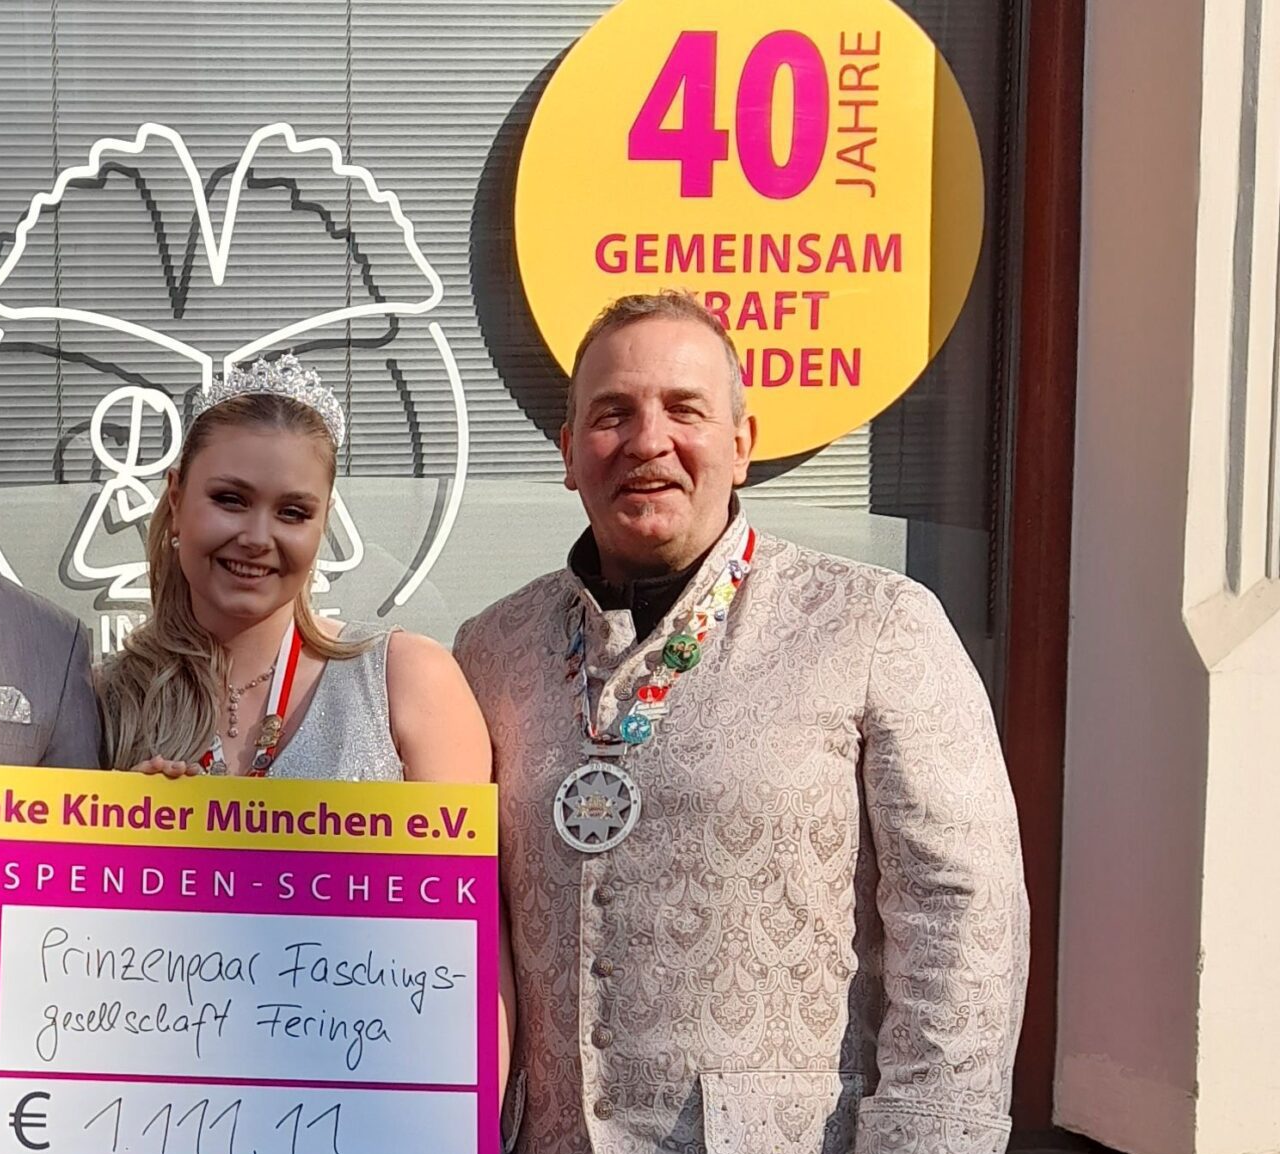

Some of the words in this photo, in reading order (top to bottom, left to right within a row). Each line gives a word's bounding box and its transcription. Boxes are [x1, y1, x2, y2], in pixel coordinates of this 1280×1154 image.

[628, 29, 830, 200] 40
[836, 30, 881, 198] JAHRE
[595, 233, 902, 274] GEMEINSAM
[694, 291, 830, 331] RAFT
[61, 793, 194, 832] Kinder
[206, 798, 393, 837] München
[406, 805, 477, 839] e.V.
[39, 926, 262, 1004] Prinzenpaar
[277, 942, 468, 1014] Faschings-
[36, 999, 230, 1062] gesellschaft
[256, 1003, 391, 1071] Feringa
[8, 1091, 51, 1151] €
